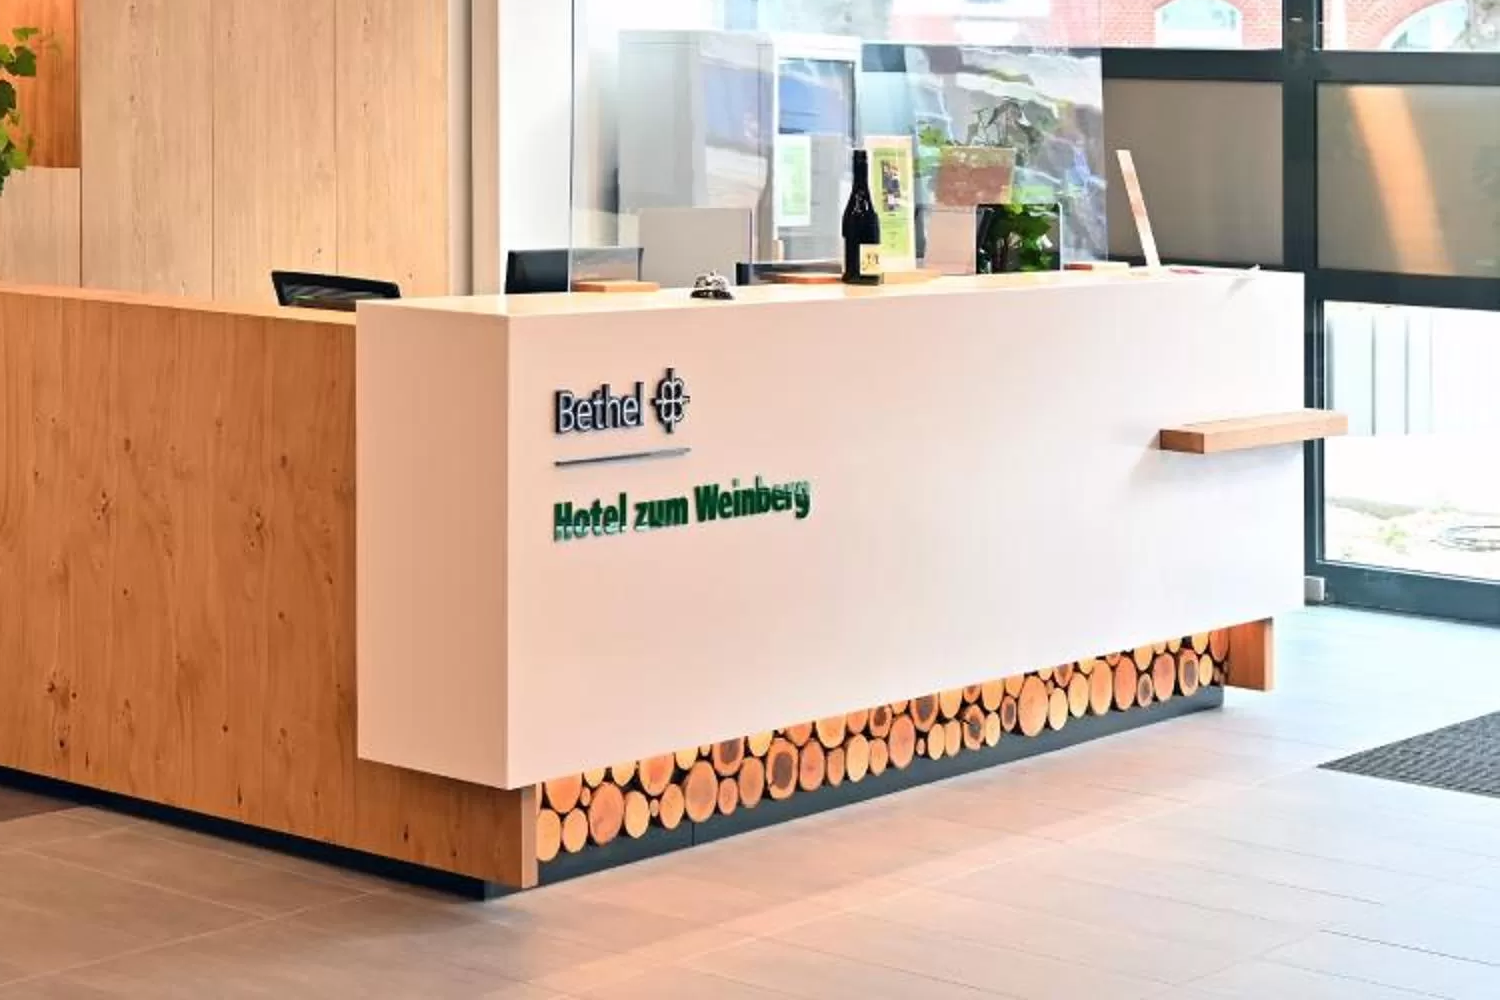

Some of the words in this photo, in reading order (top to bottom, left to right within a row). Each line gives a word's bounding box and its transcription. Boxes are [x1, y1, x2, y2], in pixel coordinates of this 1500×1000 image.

[554, 382, 645, 434] Bethel
[553, 492, 627, 541] Hotel
[634, 496, 689, 530] zum
[694, 476, 812, 520] Weinberg
